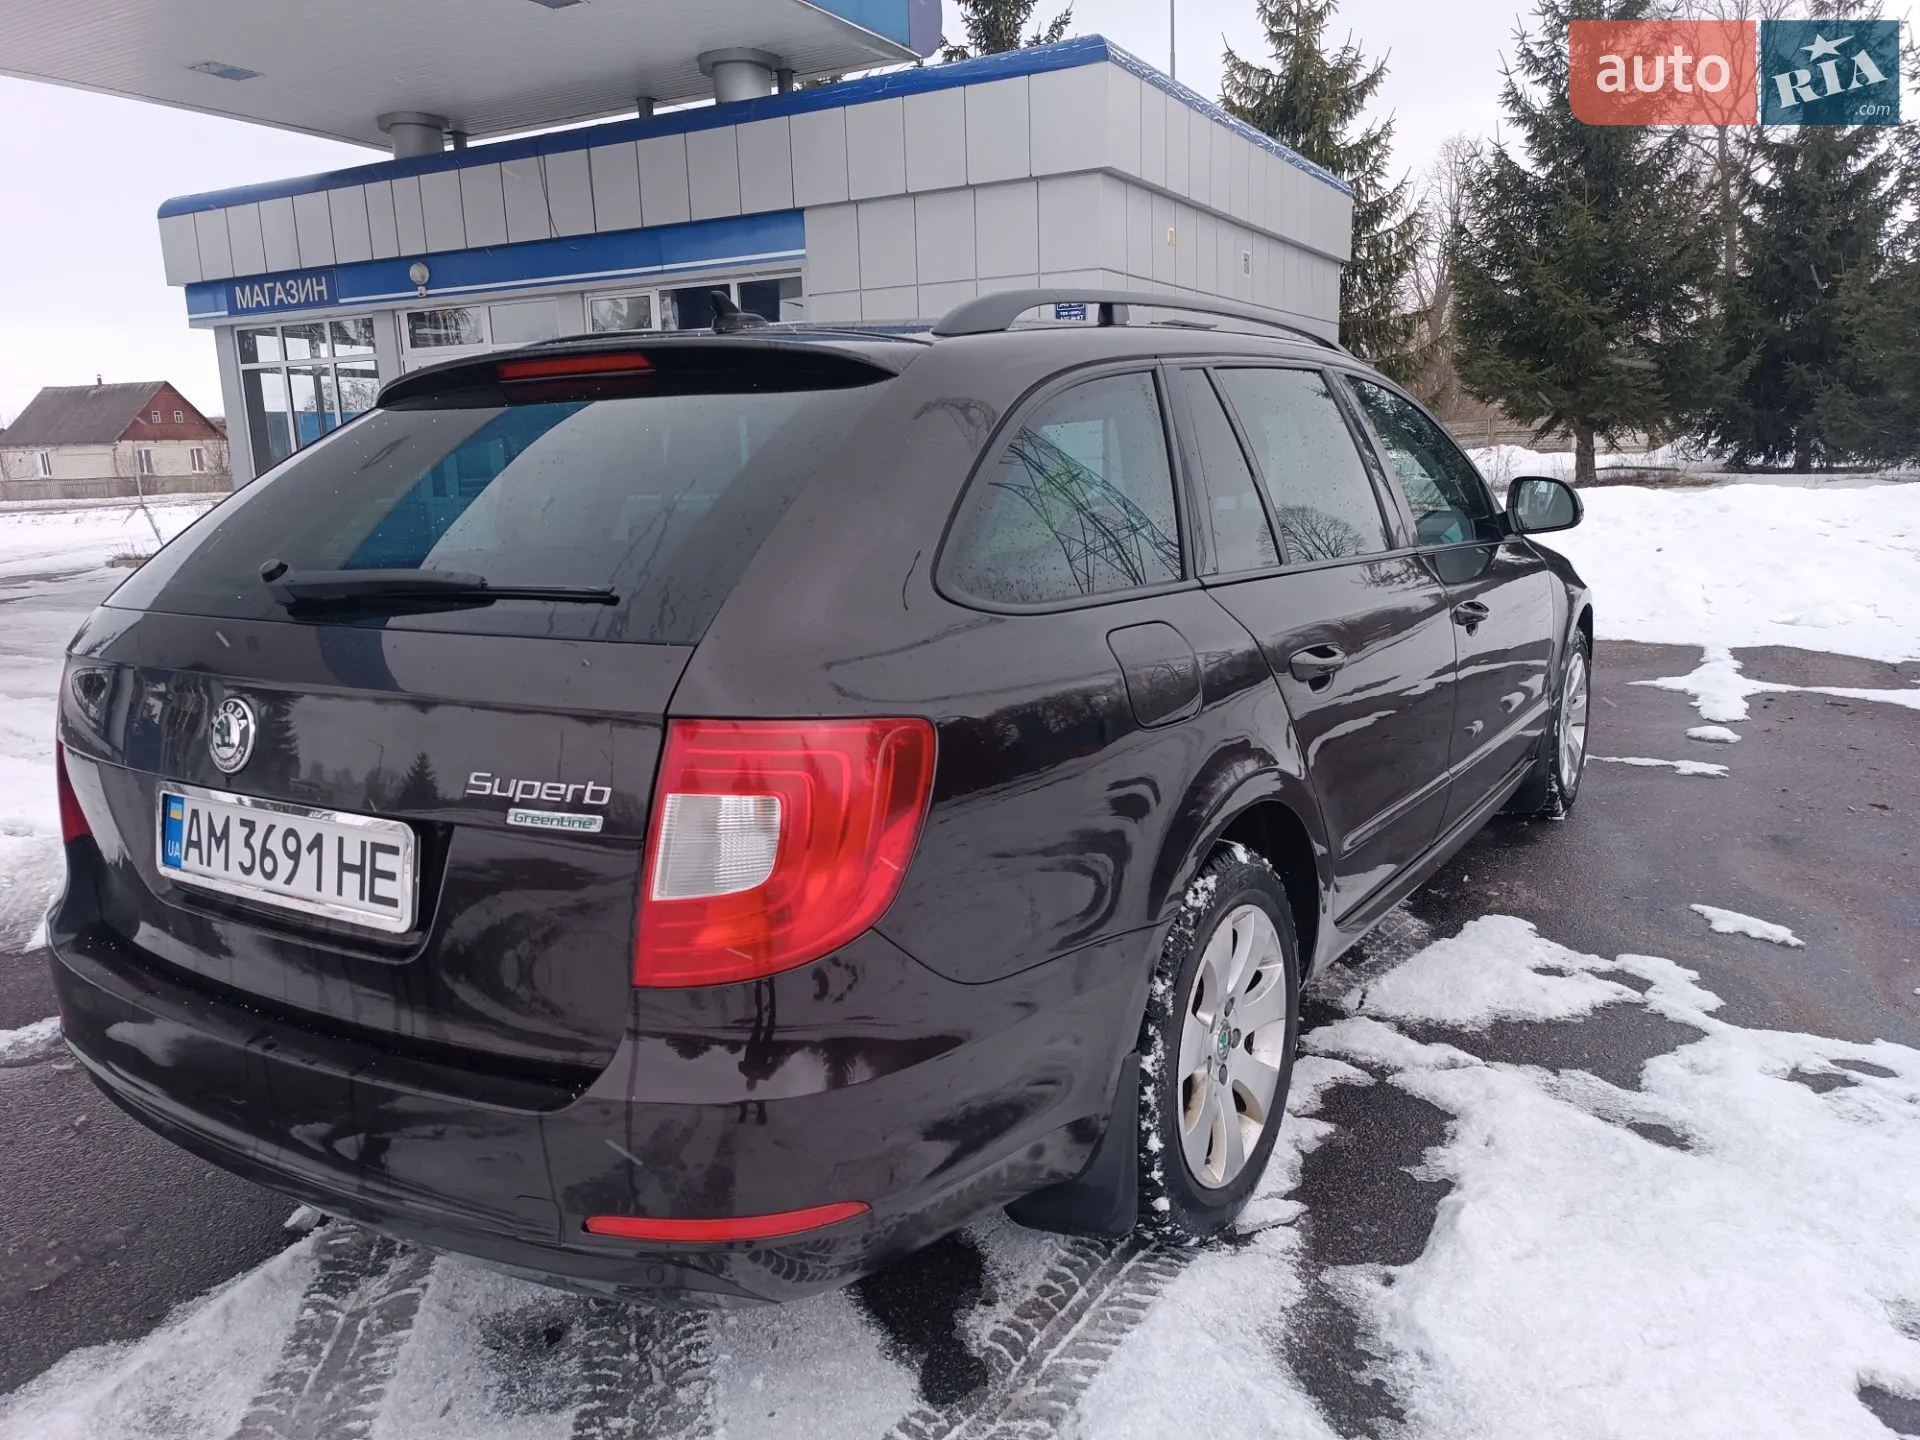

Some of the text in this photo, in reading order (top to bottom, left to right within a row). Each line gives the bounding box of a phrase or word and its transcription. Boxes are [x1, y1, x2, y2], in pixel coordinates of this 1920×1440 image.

[235, 276, 328, 309] МАГАЗИН
[466, 771, 612, 805] Superb
[167, 840, 181, 859] UA
[183, 808, 400, 908] AM 3691 HE
